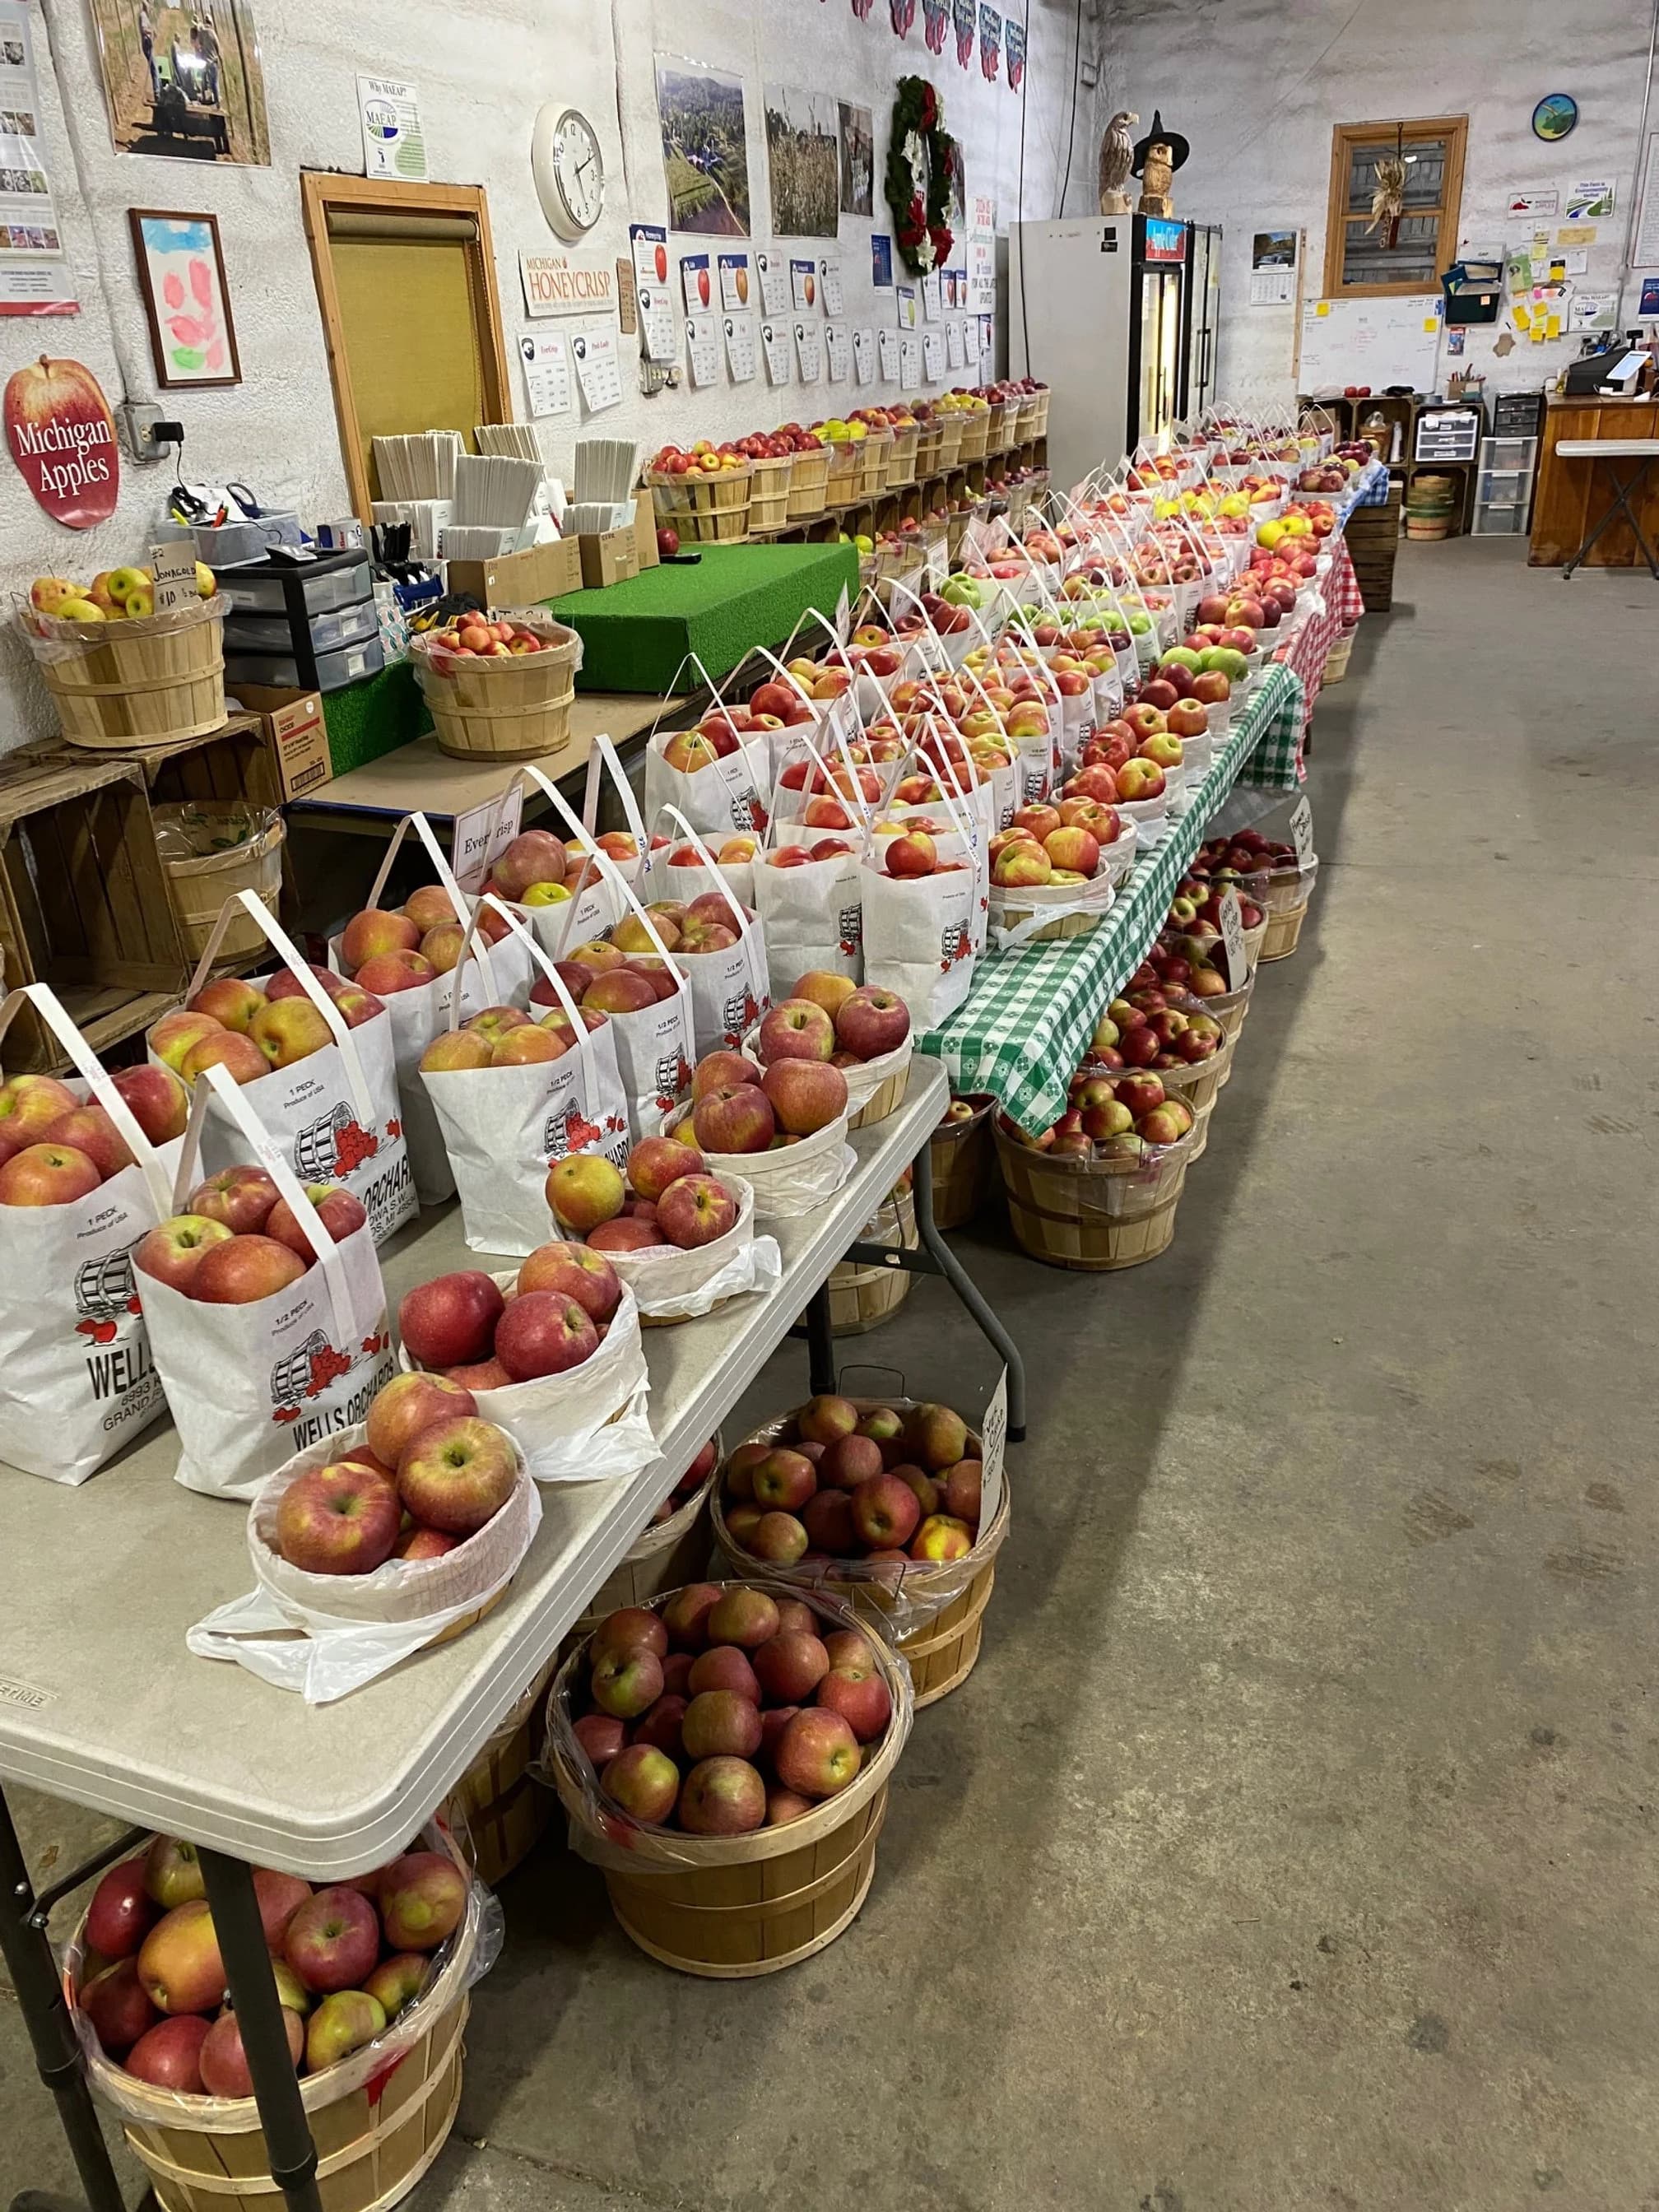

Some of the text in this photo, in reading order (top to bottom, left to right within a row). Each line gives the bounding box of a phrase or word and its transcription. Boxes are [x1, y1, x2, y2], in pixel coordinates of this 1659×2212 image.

[527, 256, 561, 272] MICHIGAN
[528, 271, 611, 300] HONEYCRISP
[13, 417, 112, 457] Michigan
[40, 453, 109, 500] Apples
[153, 562, 196, 582] JONAGOLD
[464, 820, 514, 854] Everrisp
[667, 1015, 679, 1026] PECK
[295, 1079, 316, 1094] PECK
[551, 1078, 560, 1086] 1/2
[560, 1070, 574, 1082] PECK
[283, 1095, 308, 1109] Produce
[314, 1085, 325, 1095] USA
[363, 1154, 411, 1214] ORCHAR
[77, 1221, 106, 1239] Produce
[114, 1211, 129, 1224] USA
[95, 1205, 118, 1224] PECK
[276, 1299, 308, 1325] 1/2 PECK
[272, 1318, 297, 1336] Produce
[121, 1381, 150, 1407] 6993
[103, 1396, 148, 1432] GRAND
